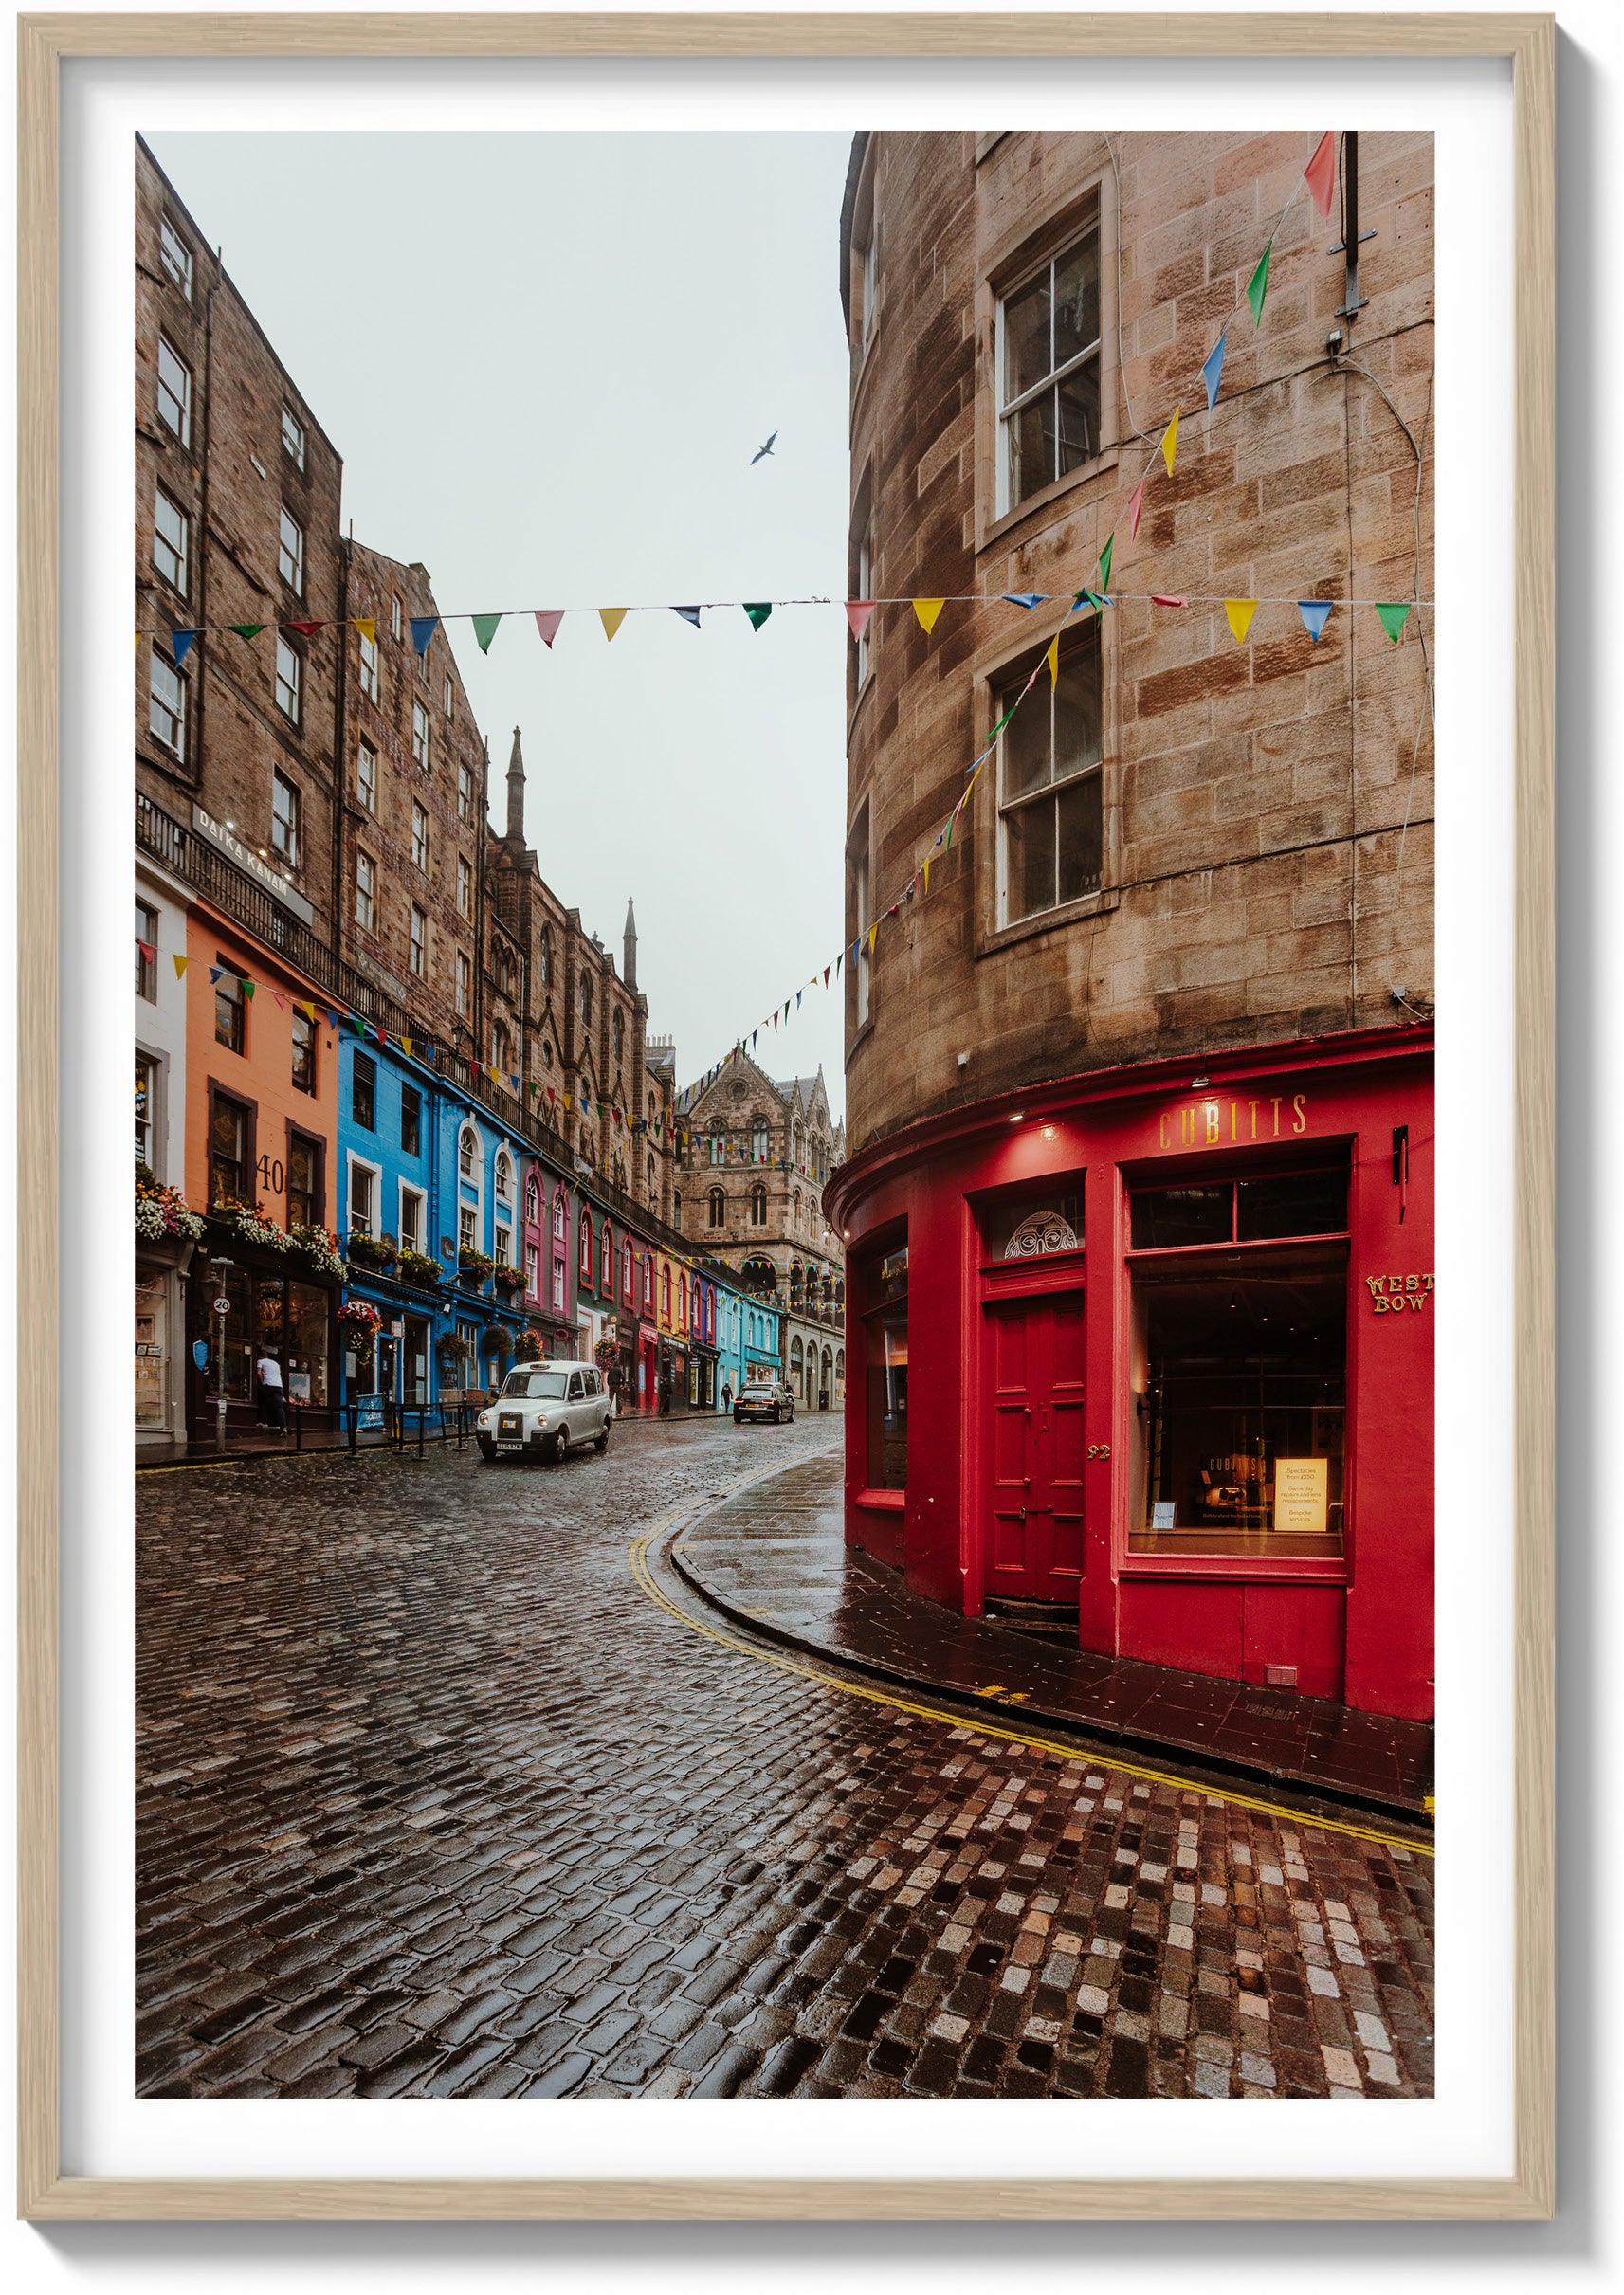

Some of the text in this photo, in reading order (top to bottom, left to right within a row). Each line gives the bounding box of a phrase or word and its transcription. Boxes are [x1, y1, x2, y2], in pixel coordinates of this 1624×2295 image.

[1159, 1094, 1306, 1150] CUBITTS
[256, 1154, 284, 1195] 40
[1365, 1273, 1435, 1296] WEST
[215, 1300, 229, 1311] 20
[1374, 1292, 1428, 1313] BOW
[1087, 1444, 1110, 1459] 92
[1210, 1458, 1256, 1471] CUBITS
